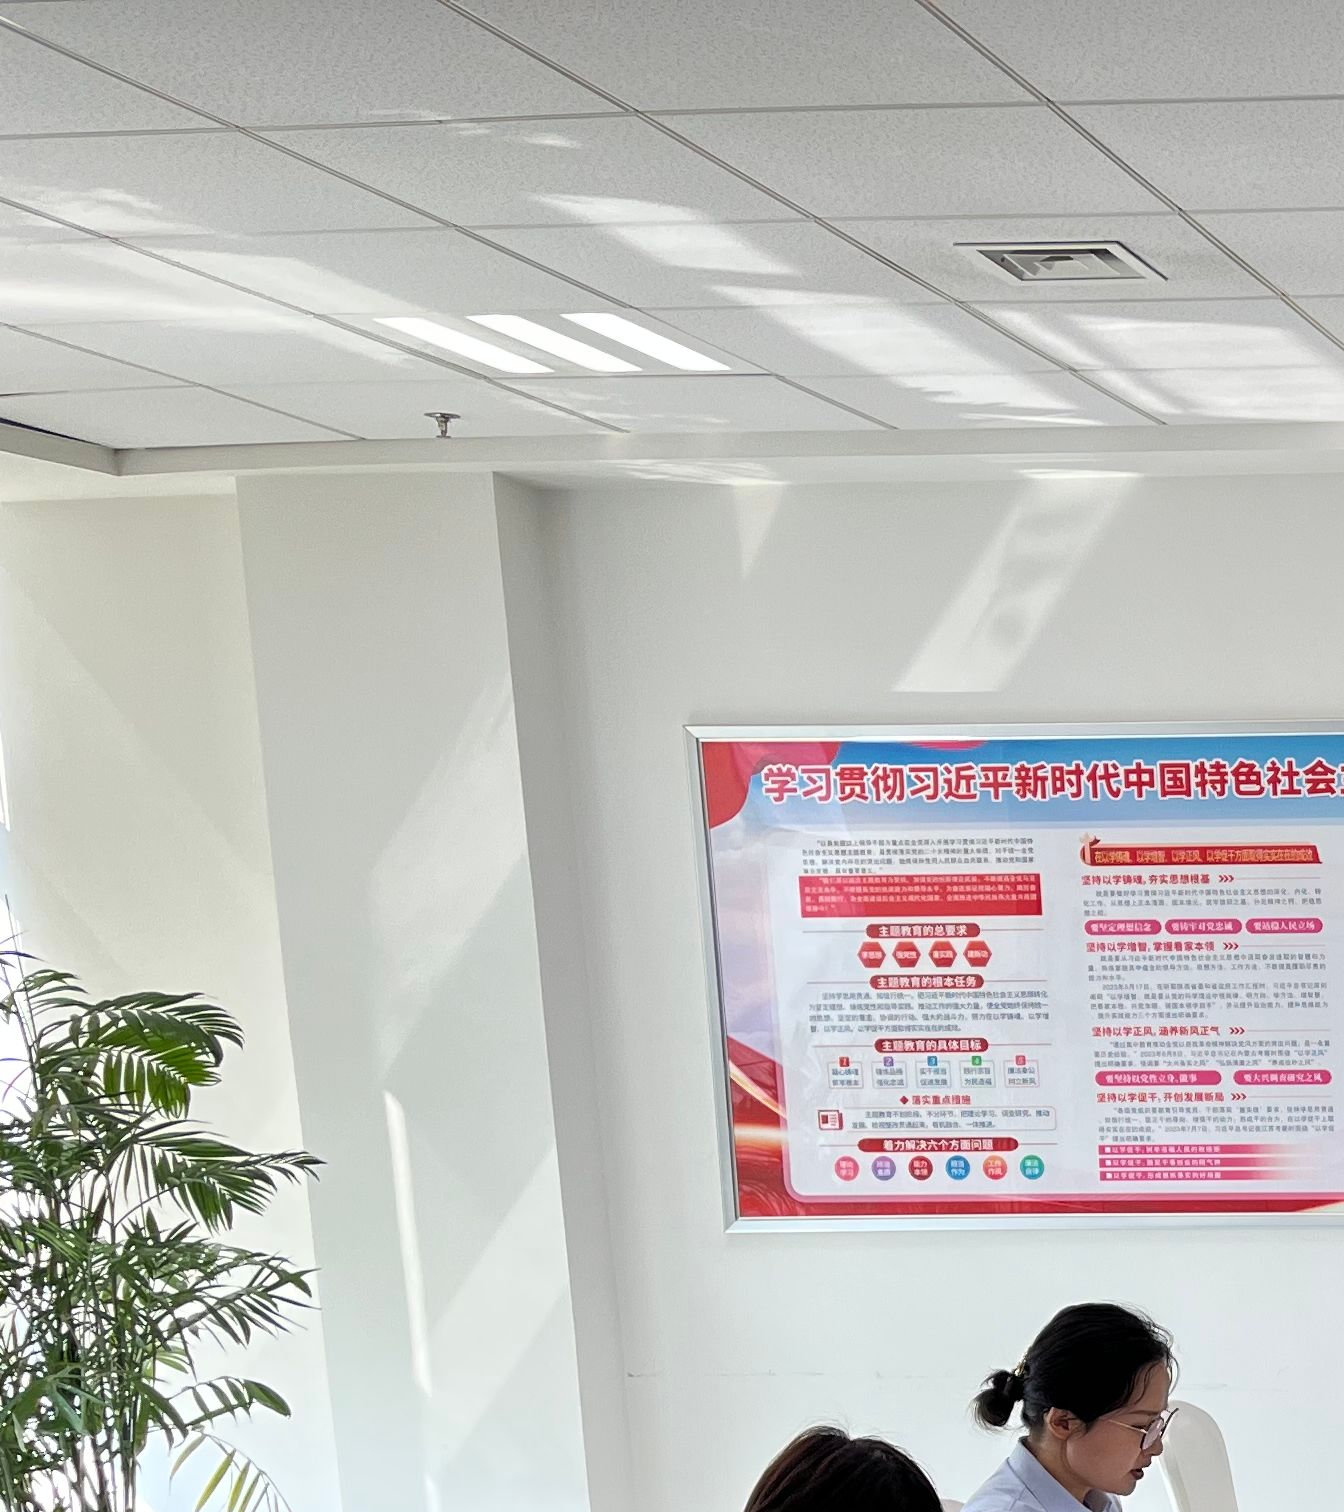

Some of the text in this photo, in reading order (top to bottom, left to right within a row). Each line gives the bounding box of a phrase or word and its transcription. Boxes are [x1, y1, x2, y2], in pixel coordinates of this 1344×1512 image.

[878, 924, 968, 937] 主题教育的总要求
[1091, 922, 1152, 933] 要坚定理想信念
[1253, 921, 1315, 931] 要站稳人民立场
[876, 975, 977, 988] 主题教育的根本任务
[882, 1038, 982, 1052] 主题教育的具体目标
[911, 1095, 971, 1105] 落实重点措施
[883, 1138, 993, 1151] 着力解决六个方面问题
